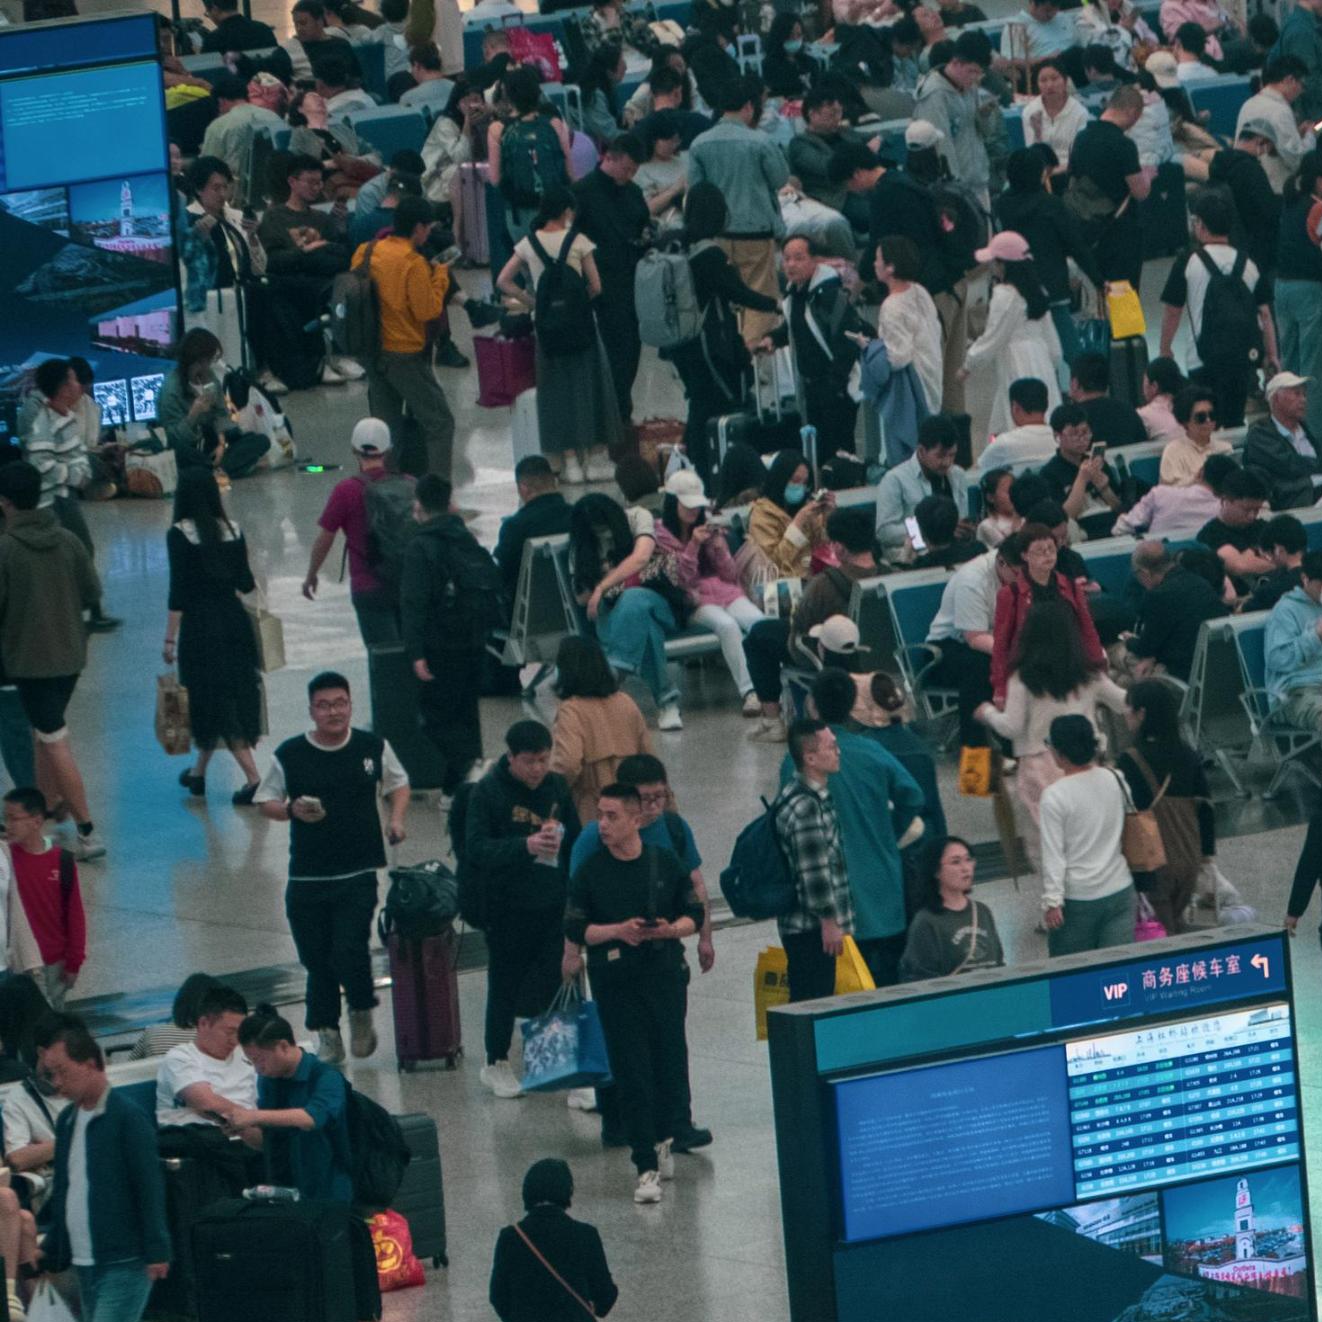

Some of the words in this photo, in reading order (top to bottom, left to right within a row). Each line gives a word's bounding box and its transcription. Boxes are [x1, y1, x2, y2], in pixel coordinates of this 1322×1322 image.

[1142, 955, 1241, 990] 商务座候车室
[1103, 982, 1128, 1001] VIP
